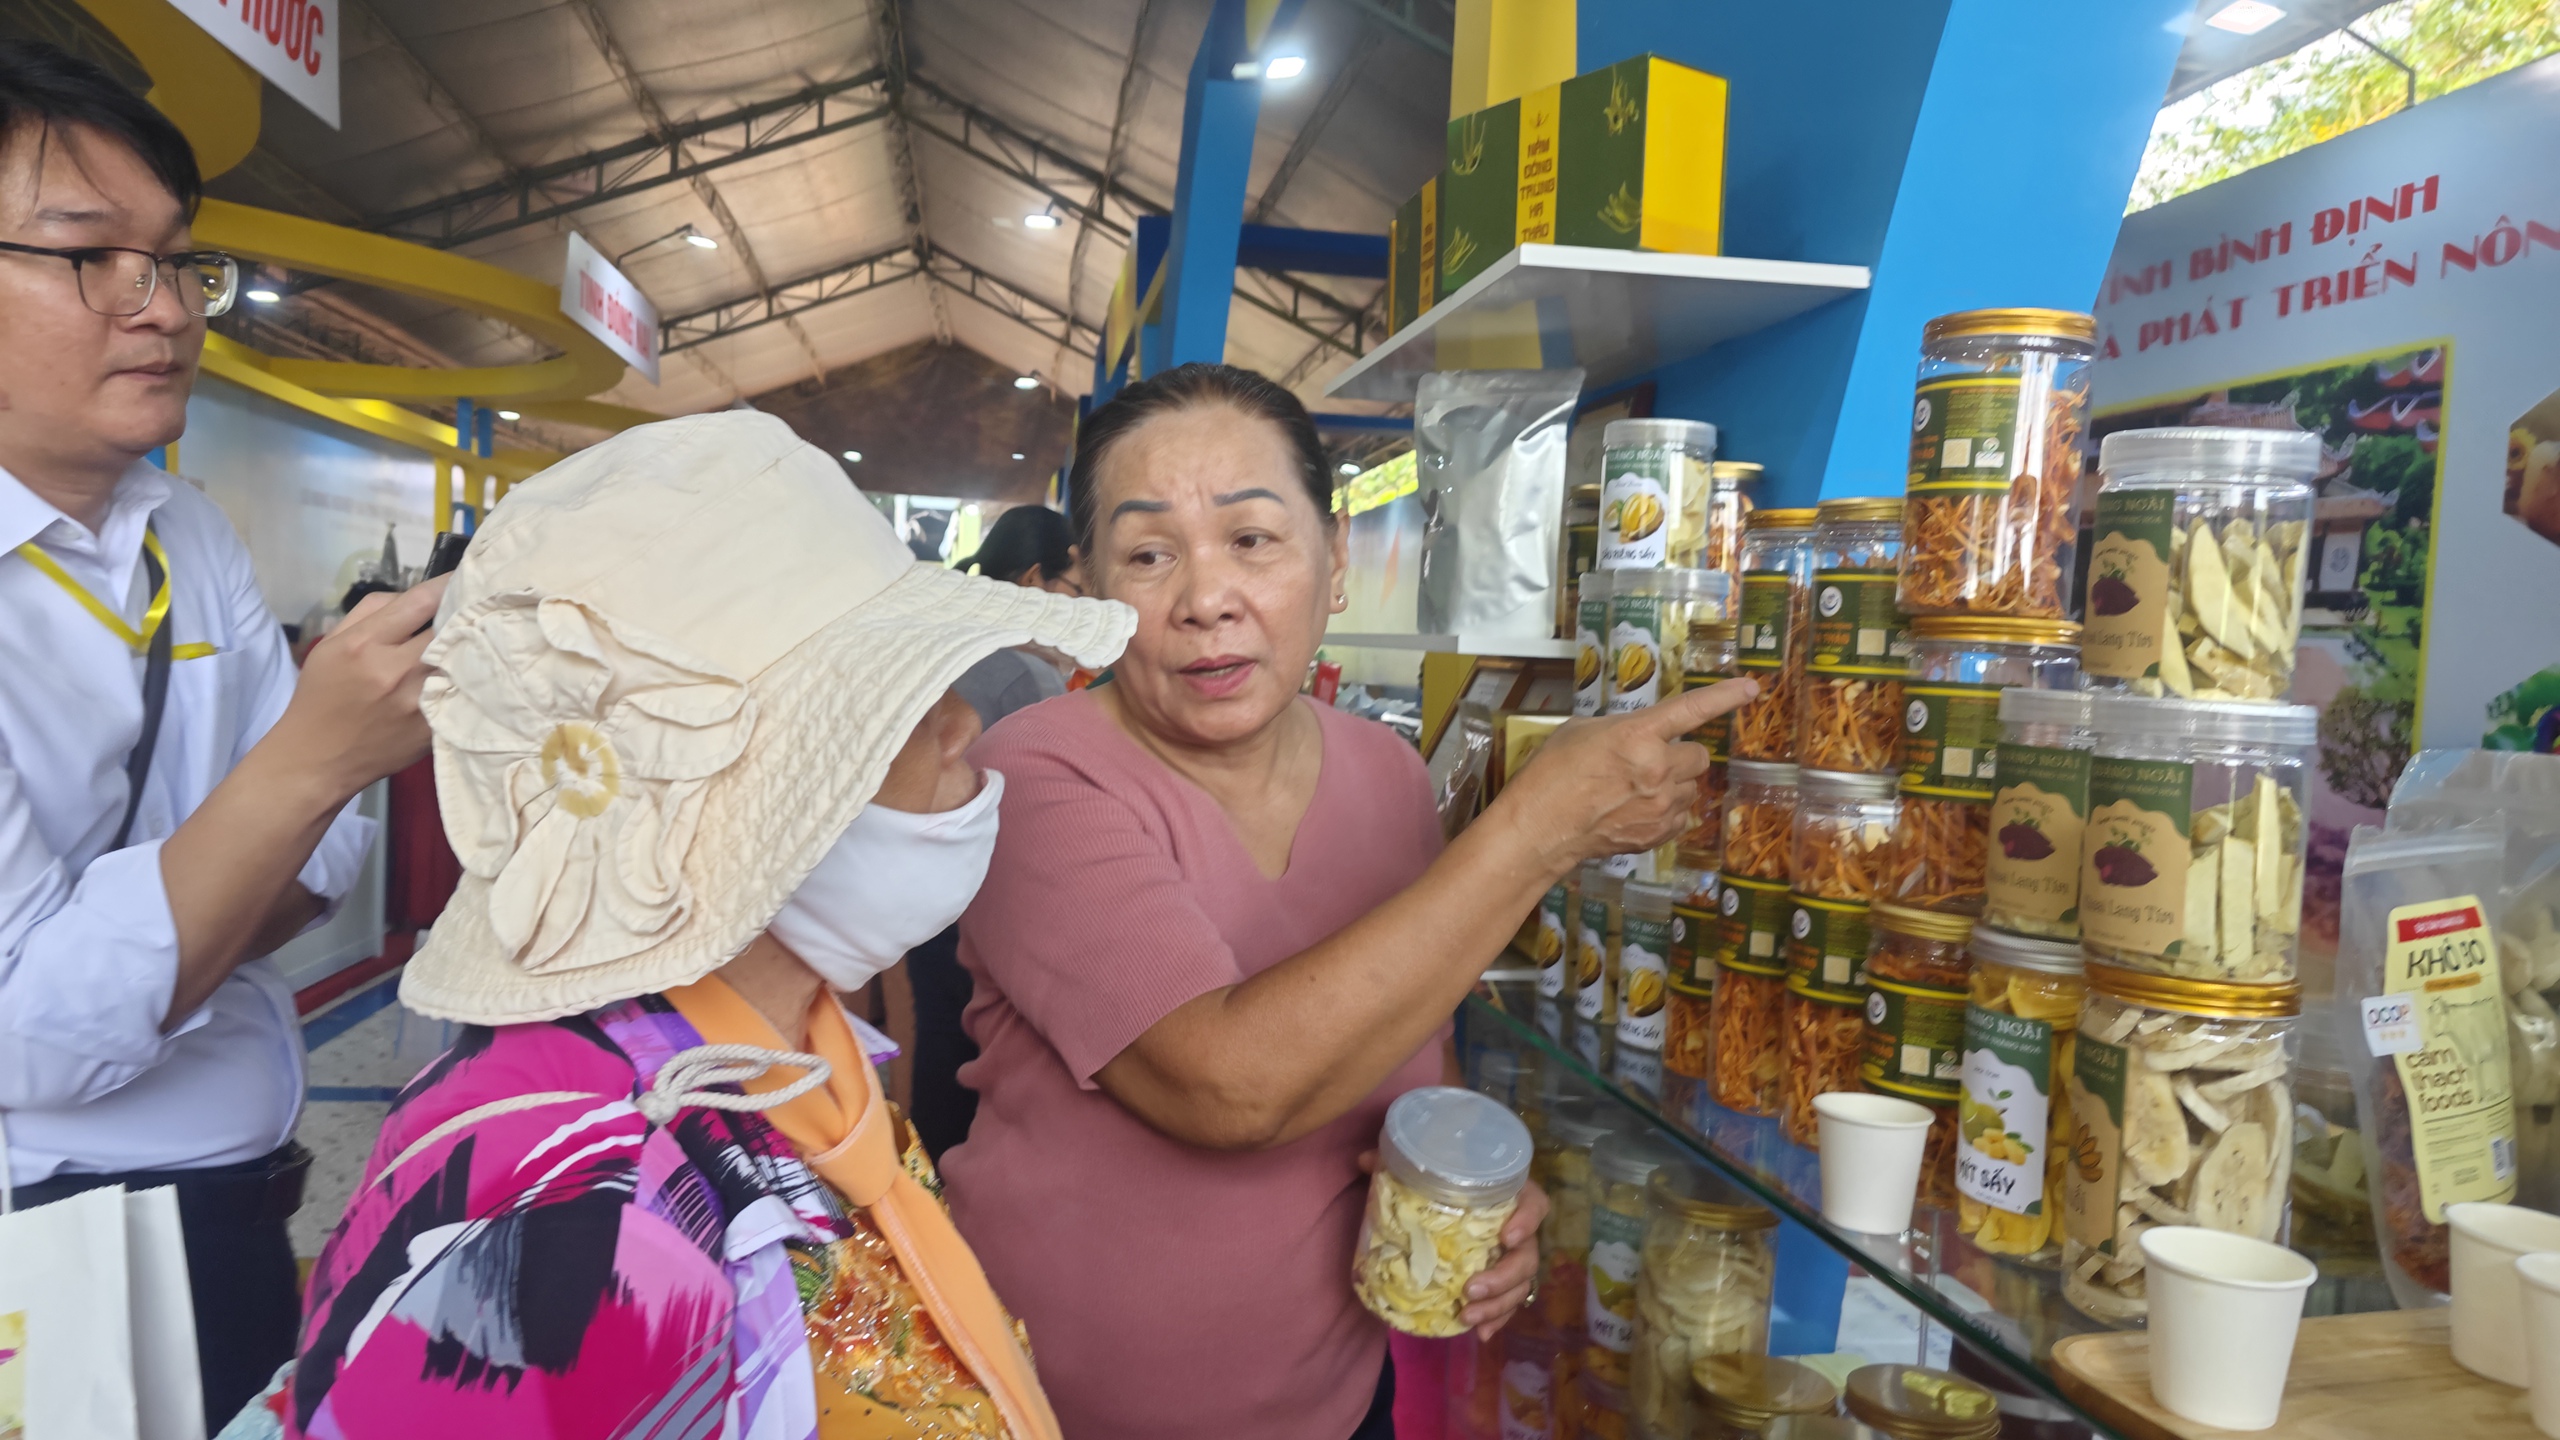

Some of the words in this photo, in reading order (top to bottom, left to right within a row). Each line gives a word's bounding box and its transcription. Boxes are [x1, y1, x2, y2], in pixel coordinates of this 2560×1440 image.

[2189, 222, 2292, 281] BÌNH
[2310, 175, 2440, 247] ĐỊNH
[2138, 295, 2248, 352] PHÁT
[2275, 243, 2418, 318] TRIỂN
[2367, 1003, 2410, 1025] OCOP
[1980, 1166, 2016, 1196] SẤY
